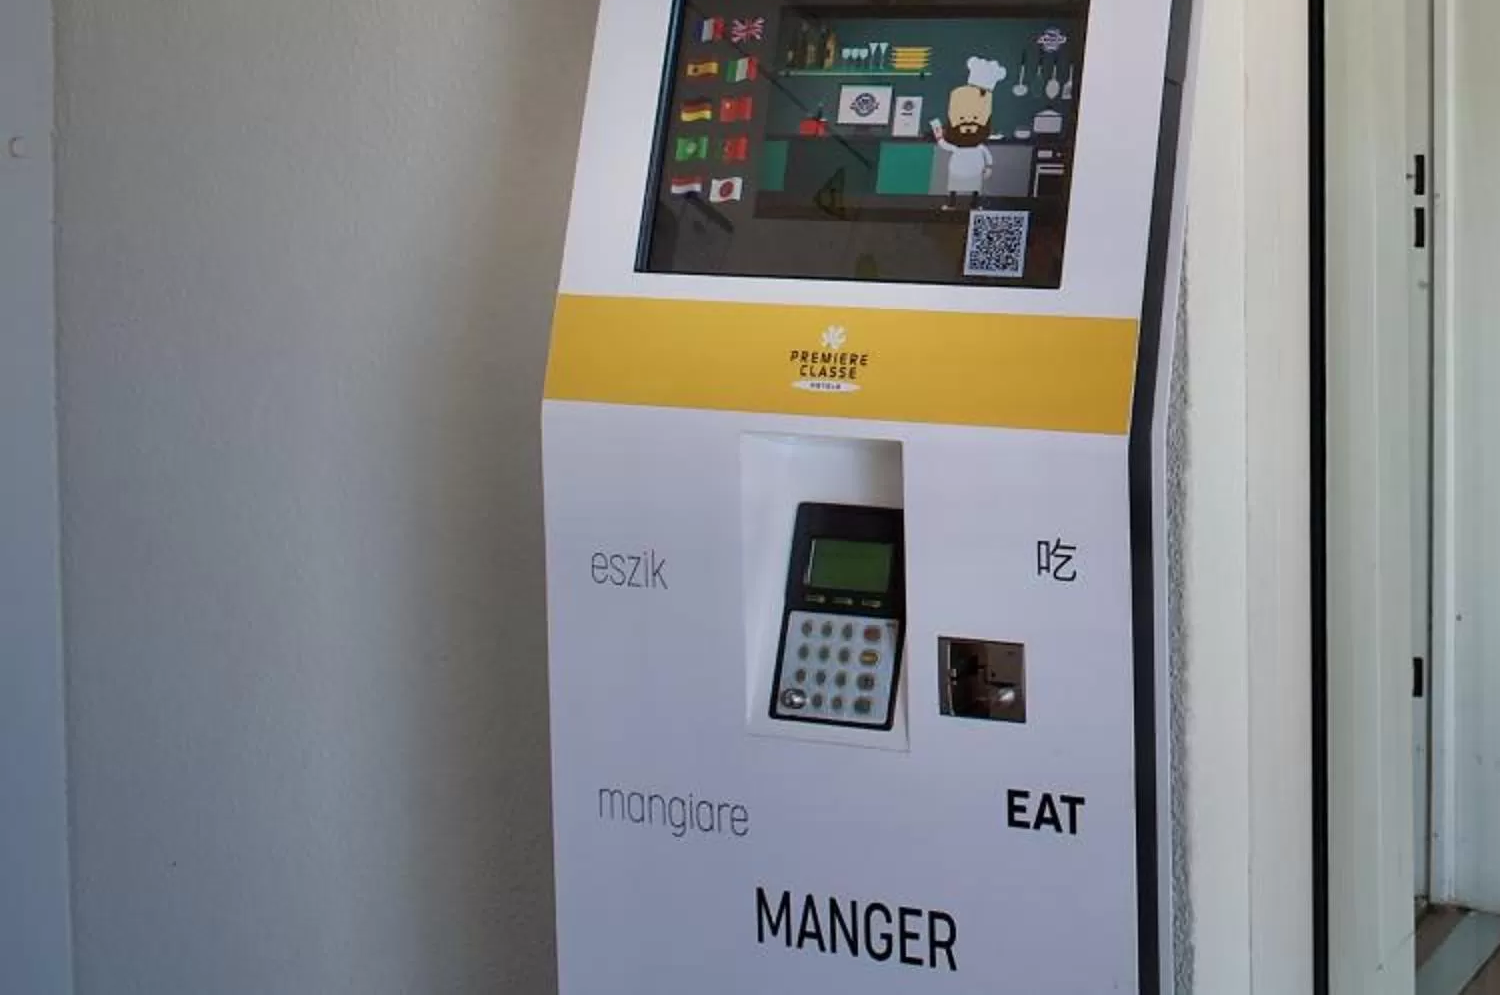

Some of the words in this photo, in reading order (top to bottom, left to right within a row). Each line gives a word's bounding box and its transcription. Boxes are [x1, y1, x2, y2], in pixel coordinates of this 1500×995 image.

[799, 364, 858, 380] CLASSE
[590, 544, 669, 590] eszik
[1036, 538, 1078, 584] 吃
[598, 786, 750, 838] mangiare
[1006, 788, 1085, 836] EAT
[754, 886, 958, 972] MANGER
